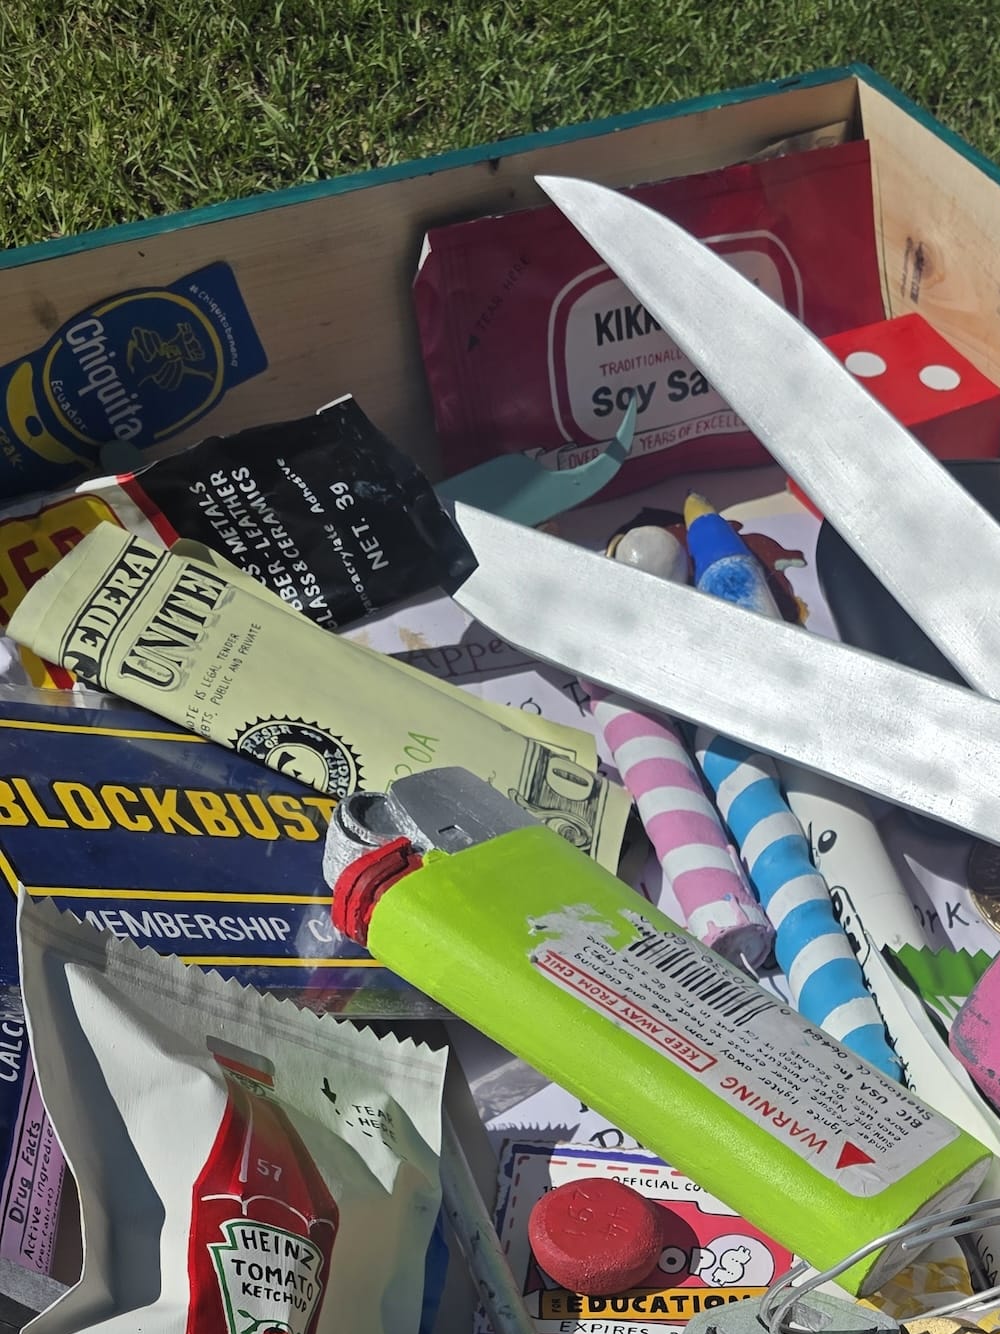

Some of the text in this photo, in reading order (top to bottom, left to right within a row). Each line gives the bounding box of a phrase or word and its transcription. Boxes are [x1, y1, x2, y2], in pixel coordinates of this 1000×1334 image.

[50, 378, 89, 432] Ecuador
[65, 317, 143, 441] Chiquita
[640, 429, 677, 451] YEARS
[678, 424, 693, 438] OF
[210, 470, 271, 551] LEATHER
[232, 466, 300, 559] CERAMICS
[276, 457, 325, 515] Adhesive
[189, 481, 248, 555] METALS
[351, 516, 389, 571] NET.
[201, 632, 241, 689] LEGAL TENDER
[210, 622, 263, 706] PUBLIC AND PRIVATE
[577, 975, 619, 1010] FROM
[619, 1002, 663, 1039] AWAY
[573, 950, 845, 1137] Ignite lighter away from face and clothing
[638, 979, 801, 1093] Never heat above
[663, 1032, 701, 1064] KEEP
[351, 1103, 395, 1127] TEAR
[719, 1070, 829, 1157] WARNING
[812, 1085, 848, 1114] Never
[830, 1062, 923, 1131] BIC USA Inc
[882, 1115, 910, 1137] more
[8, 1119, 41, 1225] Drug Facts
[256, 1157, 283, 1183] 57
[24, 1204, 42, 1261] Active
[240, 1228, 315, 1272] HEINZ
[230, 1258, 315, 1303] TOMATO
[241, 1282, 308, 1314] KETCHUP
